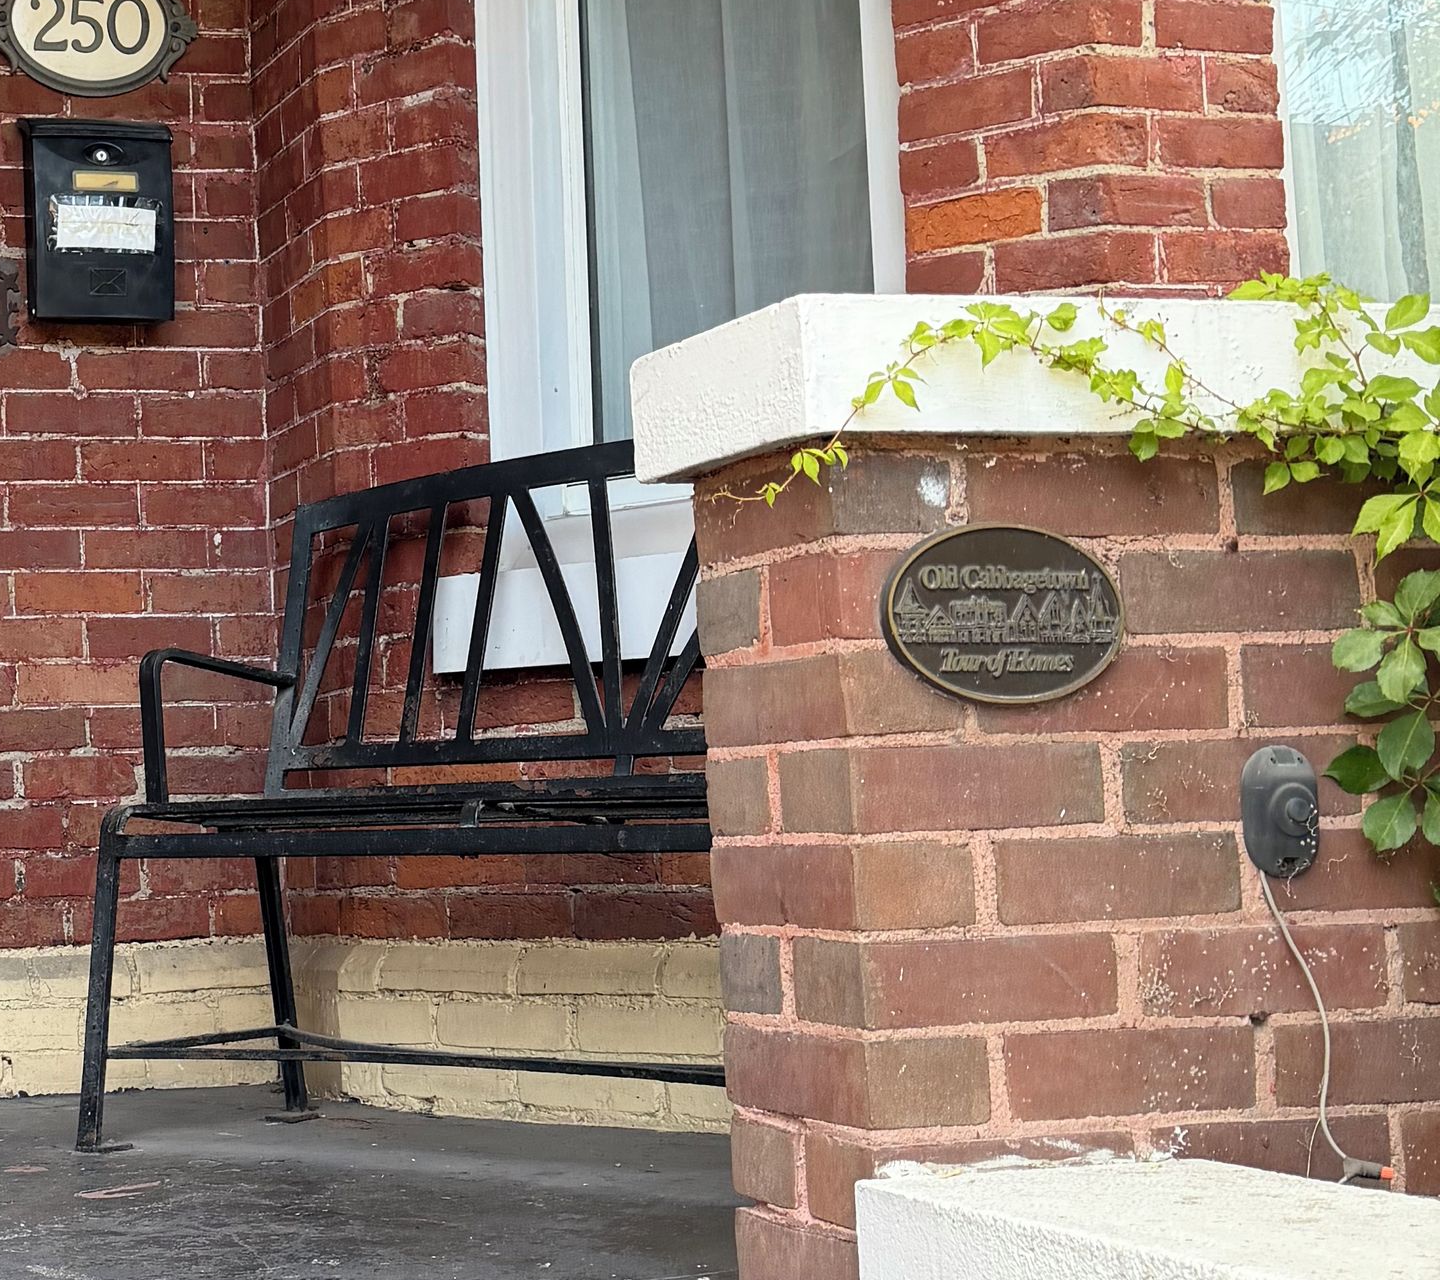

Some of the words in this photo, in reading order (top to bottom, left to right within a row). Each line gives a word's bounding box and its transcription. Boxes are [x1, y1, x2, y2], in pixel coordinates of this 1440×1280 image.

[918, 564, 960, 591] Old
[961, 564, 1090, 595] Cabbagetown
[939, 647, 986, 673] Tour
[986, 648, 1006, 678] of
[1006, 648, 1075, 674] Homes
